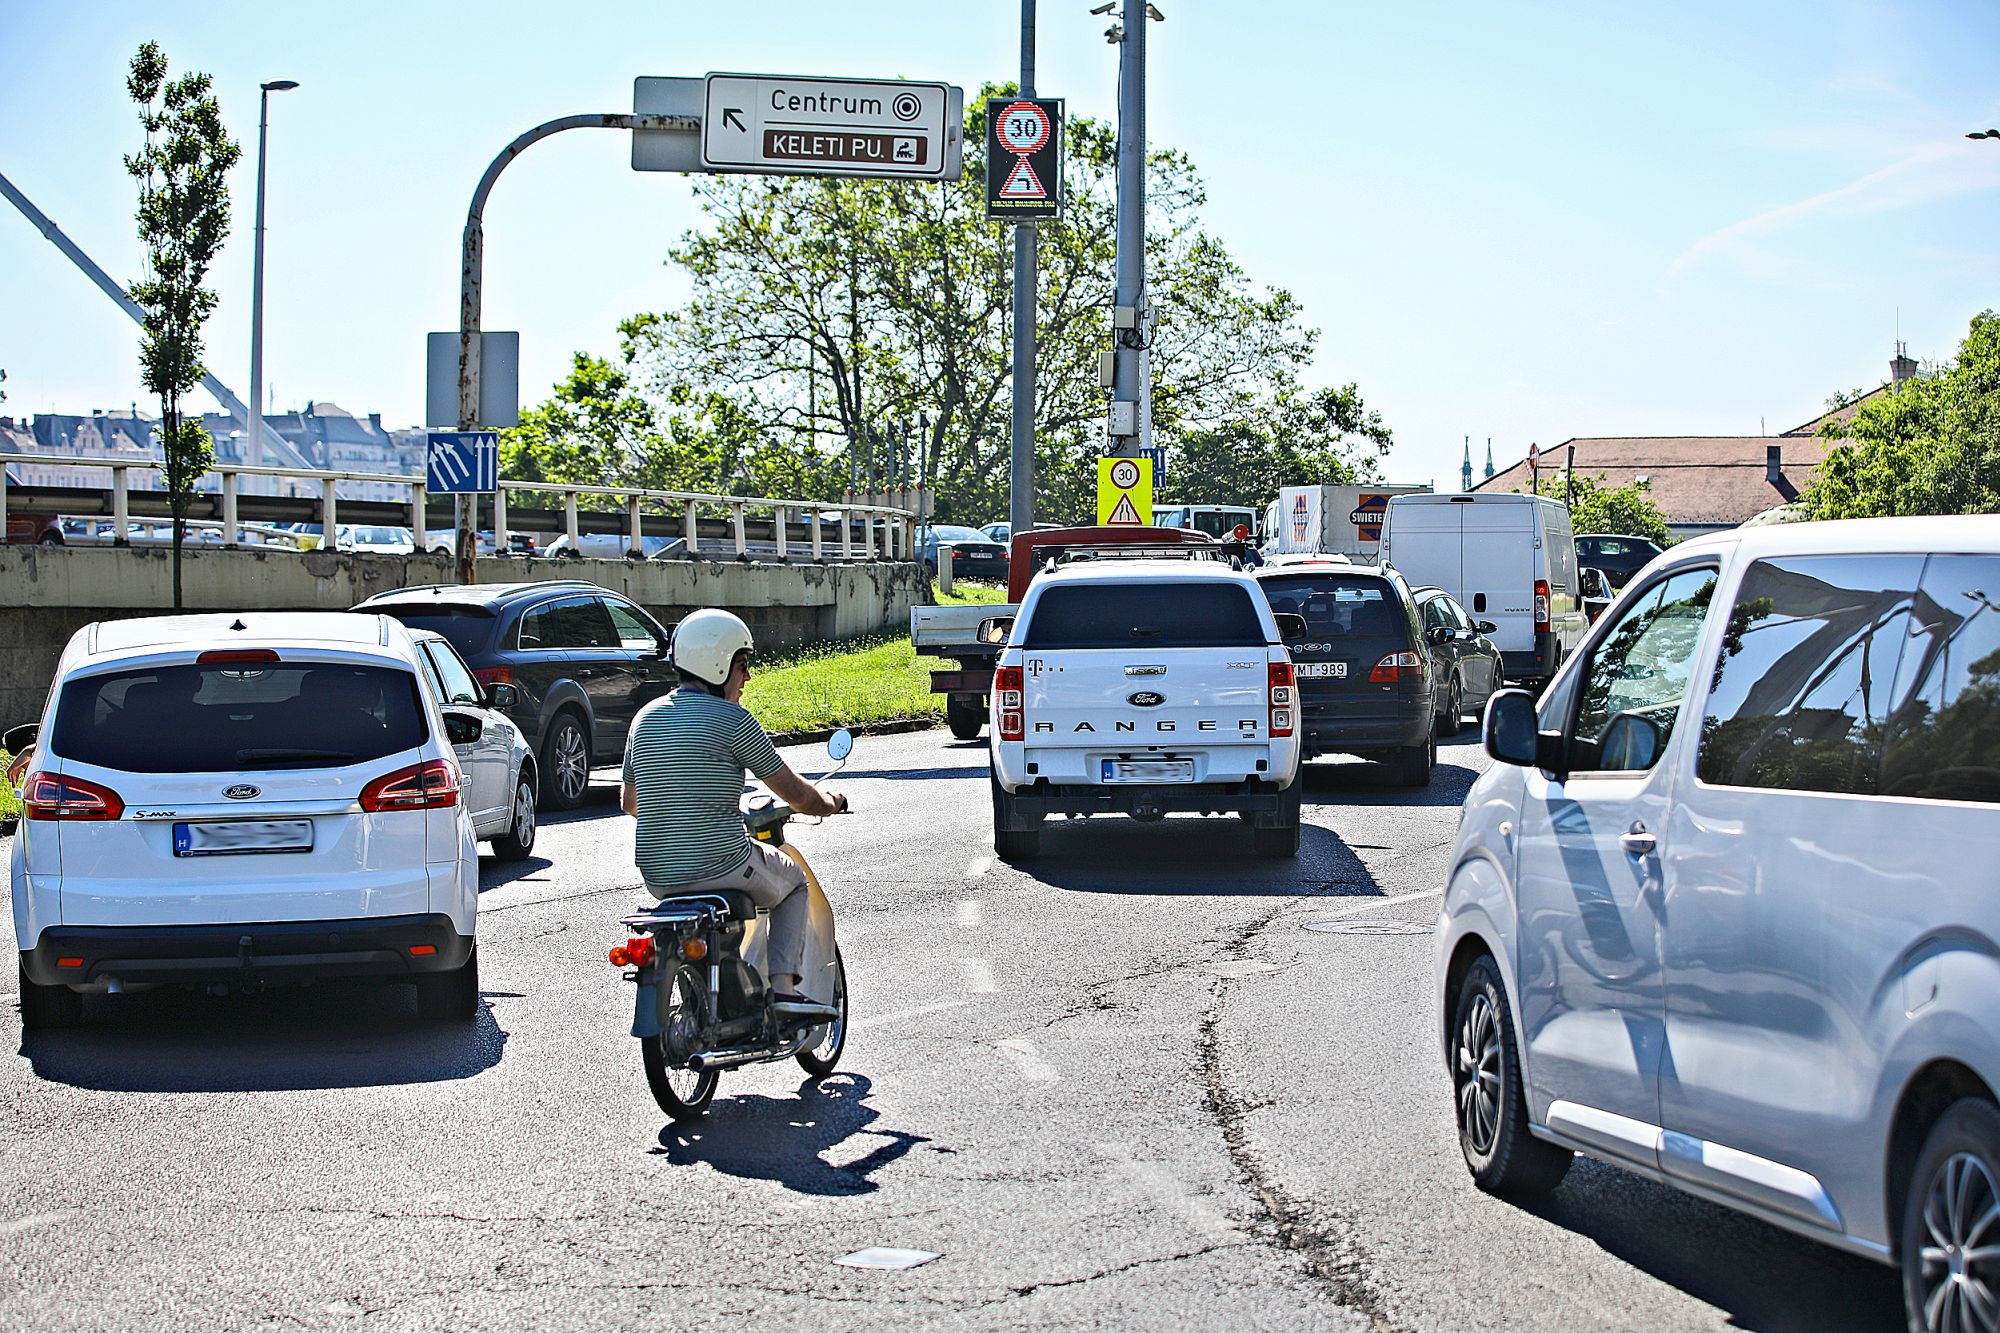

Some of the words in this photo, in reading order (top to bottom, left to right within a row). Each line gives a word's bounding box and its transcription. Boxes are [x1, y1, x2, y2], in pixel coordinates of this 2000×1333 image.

[771, 89, 882, 115] Centrum
[1010, 119, 1036, 139] 30
[773, 134, 843, 156] KELETI
[851, 138, 885, 159] PU.
[1118, 468, 1132, 481] 30
[1351, 512, 1385, 523] SWIETE
[1134, 693, 1157, 704] Ford
[1035, 720, 1258, 732] RANGER
[230, 786, 252, 797] Ford
[178, 839, 186, 848] H
